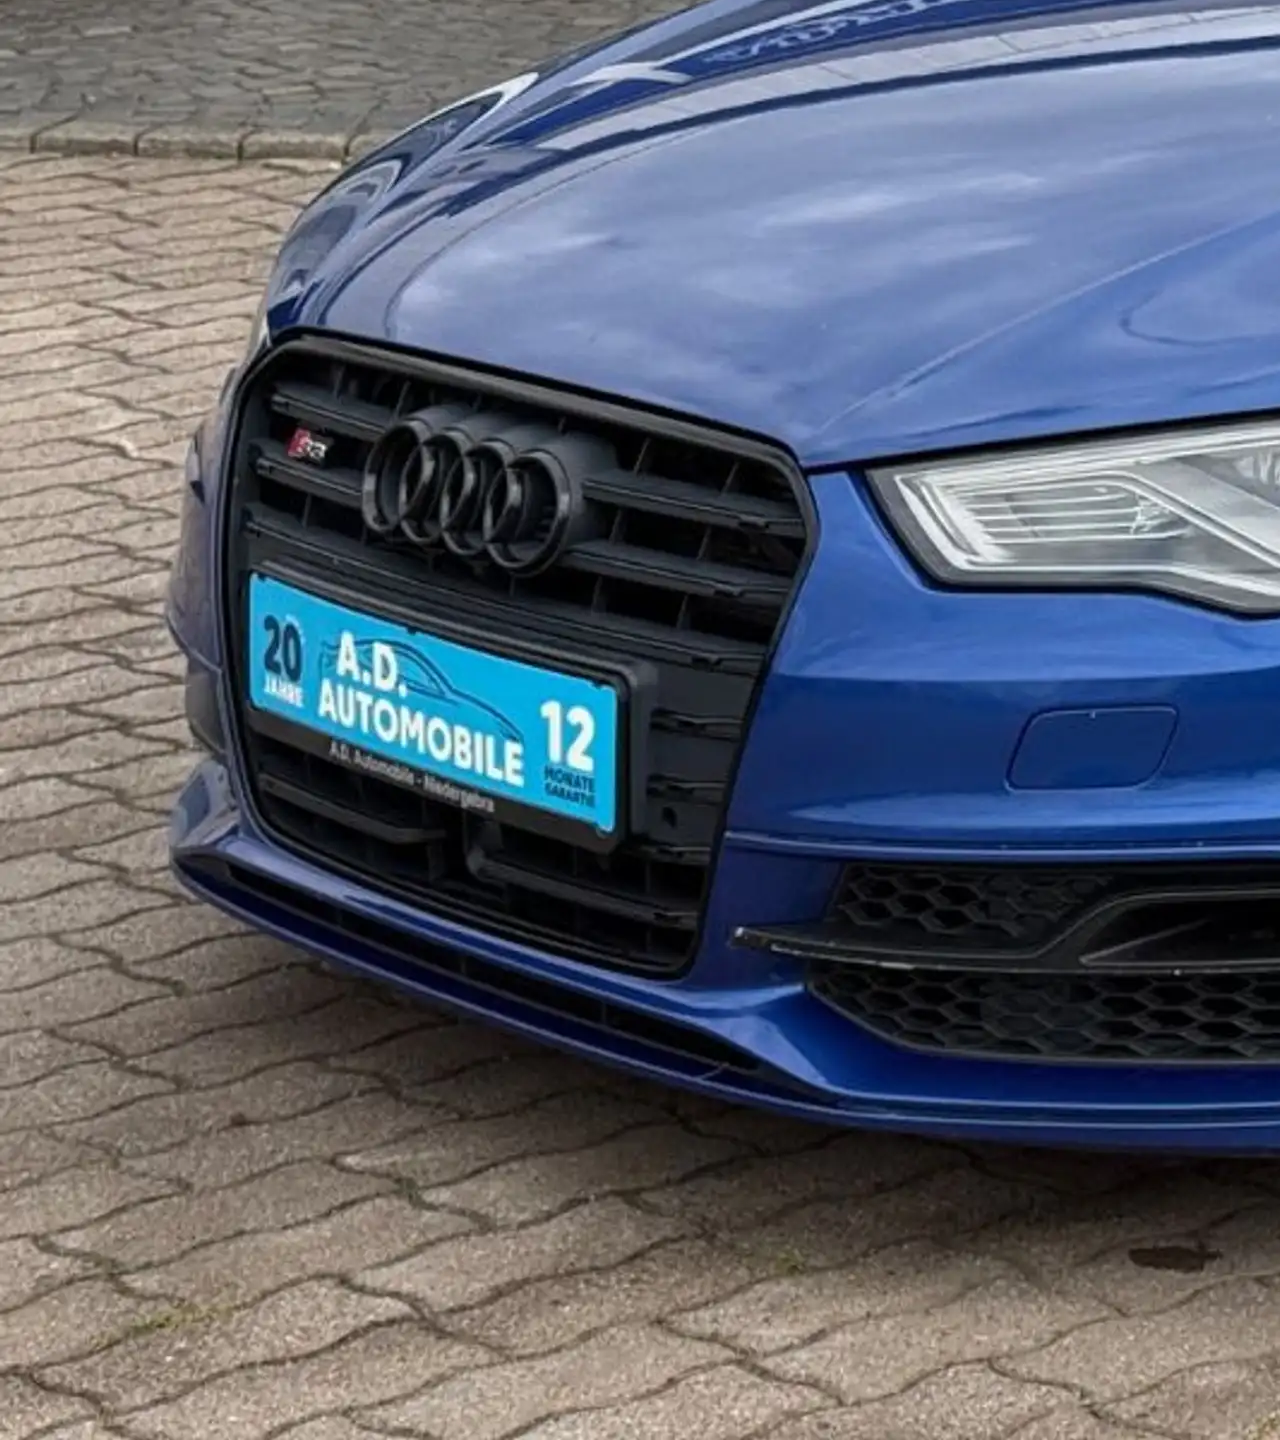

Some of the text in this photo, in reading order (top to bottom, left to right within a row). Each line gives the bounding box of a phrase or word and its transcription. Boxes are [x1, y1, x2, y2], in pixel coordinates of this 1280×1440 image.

[263, 613, 303, 684] 20
[336, 630, 408, 698] A.D.
[318, 677, 525, 788] AUTOMOBILE
[540, 700, 594, 771] 12
